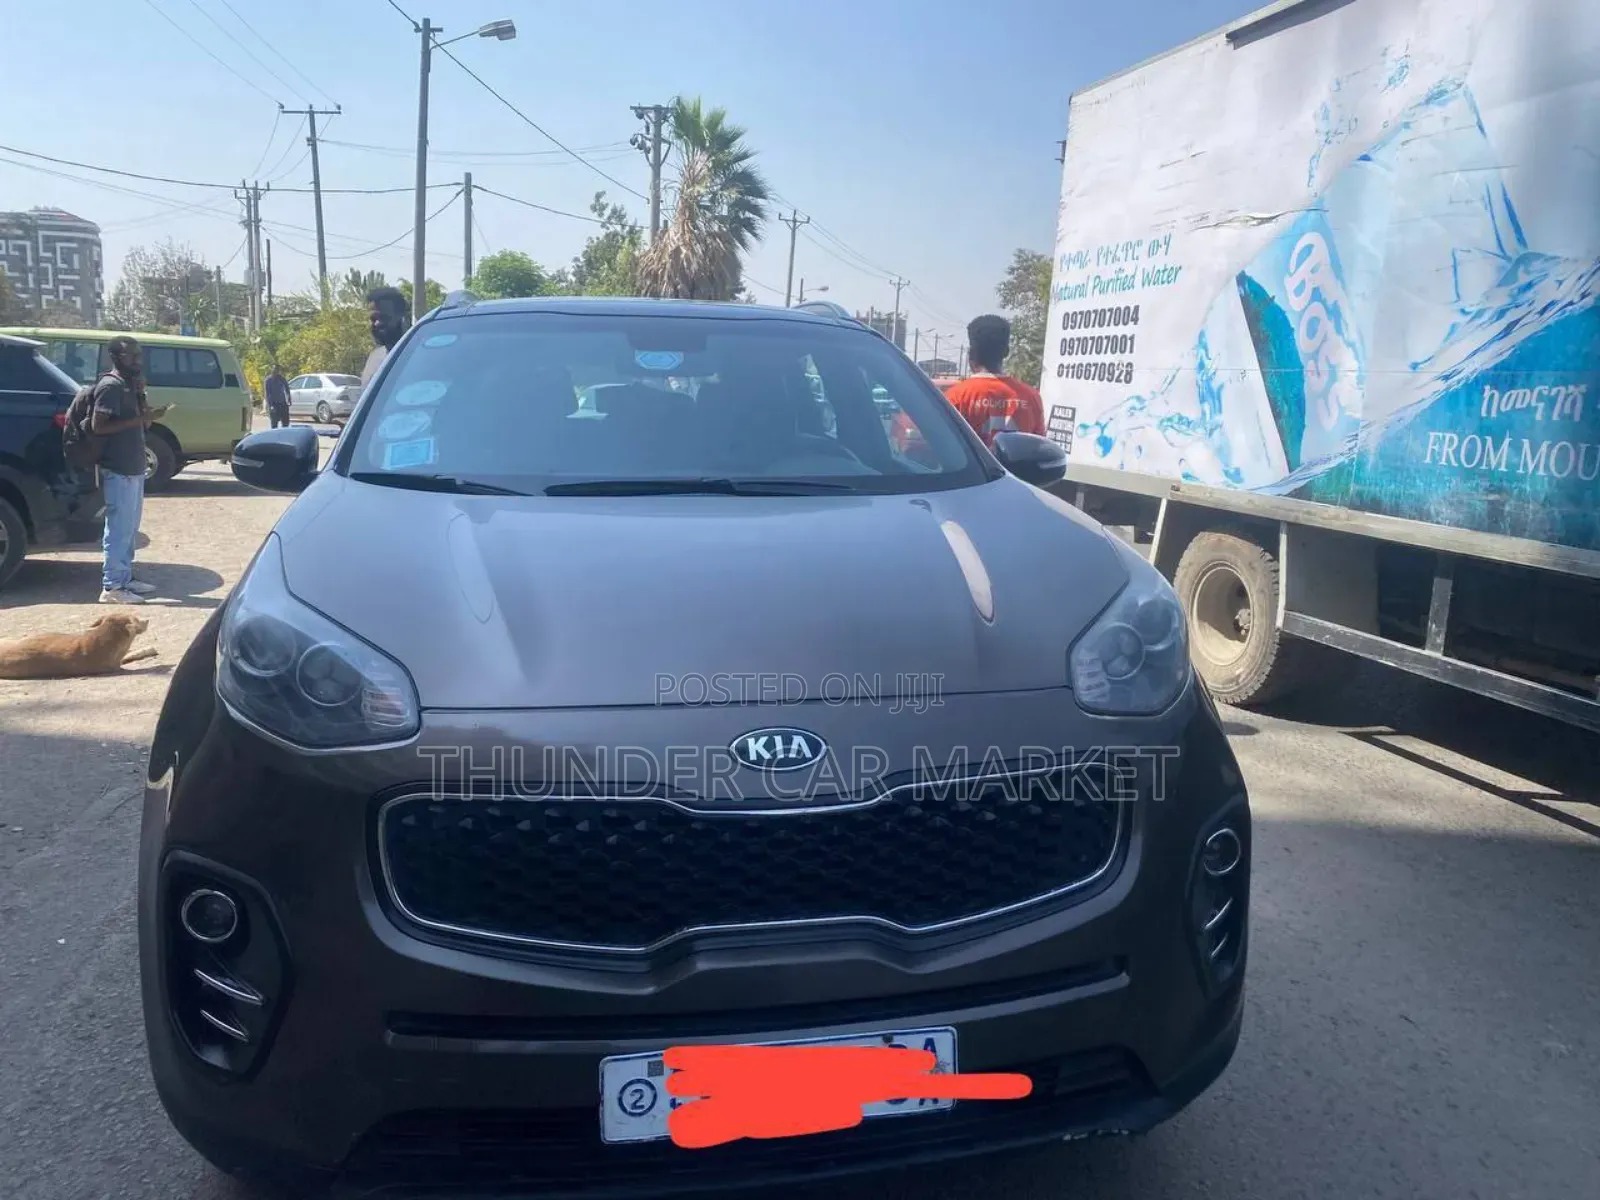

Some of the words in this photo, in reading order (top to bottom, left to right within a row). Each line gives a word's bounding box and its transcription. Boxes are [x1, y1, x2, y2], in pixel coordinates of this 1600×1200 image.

[1092, 265, 1139, 298] Purified
[1141, 264, 1183, 288] Water
[1062, 304, 1140, 331] 0970707004
[1060, 334, 1135, 356] 0970707001
[1056, 361, 1134, 385] 0116670928
[1422, 430, 1513, 472] FROM
[1517, 438, 1600, 481] MOU
[746, 735, 813, 760] KIA
[630, 1088, 645, 1110] 2
